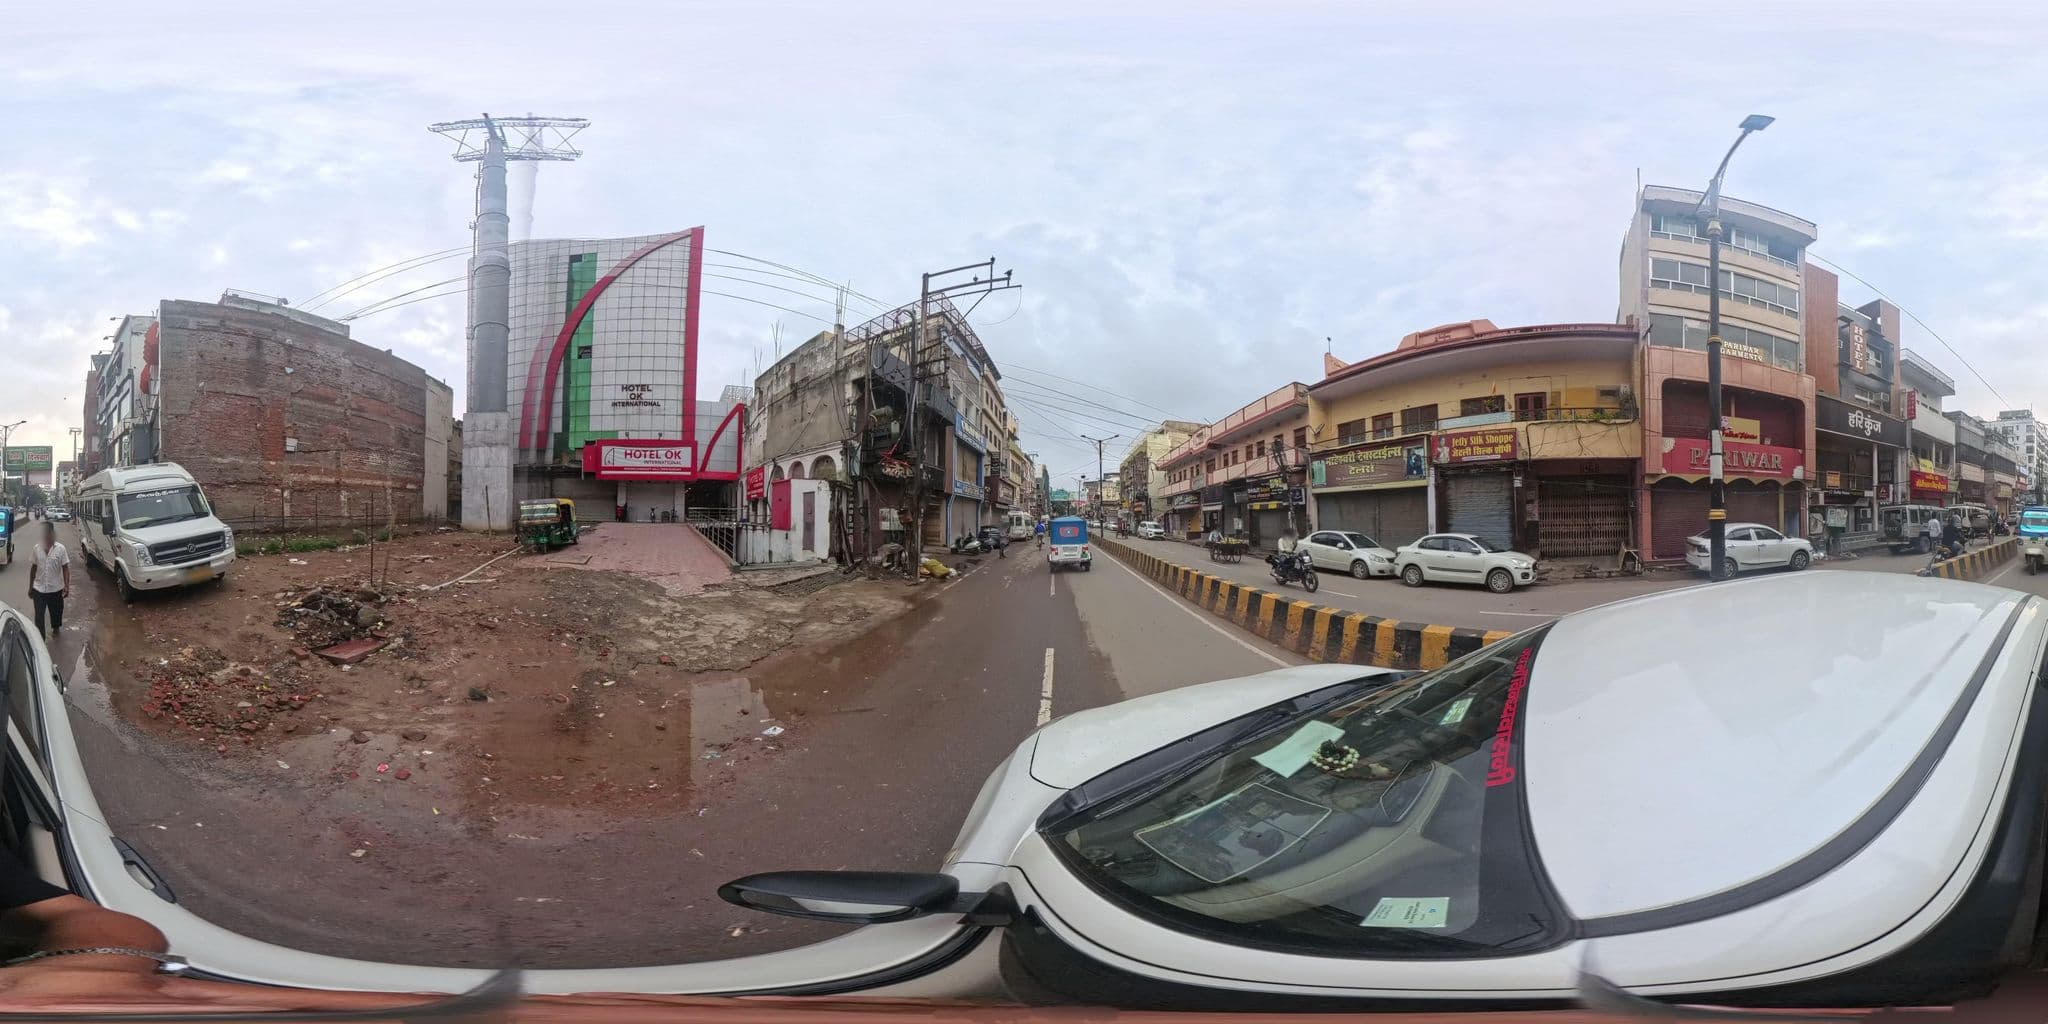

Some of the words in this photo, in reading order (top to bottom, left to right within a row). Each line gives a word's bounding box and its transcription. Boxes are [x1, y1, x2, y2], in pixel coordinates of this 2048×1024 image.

[1723, 341, 1760, 354] PARIWAR
[1854, 325, 1863, 370] HOTEL
[621, 384, 652, 392] HOTEL
[1470, 435, 1484, 445] Silk
[1485, 434, 1514, 445] Shoppe
[624, 450, 661, 459] HOTEL
[665, 450, 682, 460] OK
[1690, 447, 1782, 469] PARIWAR
